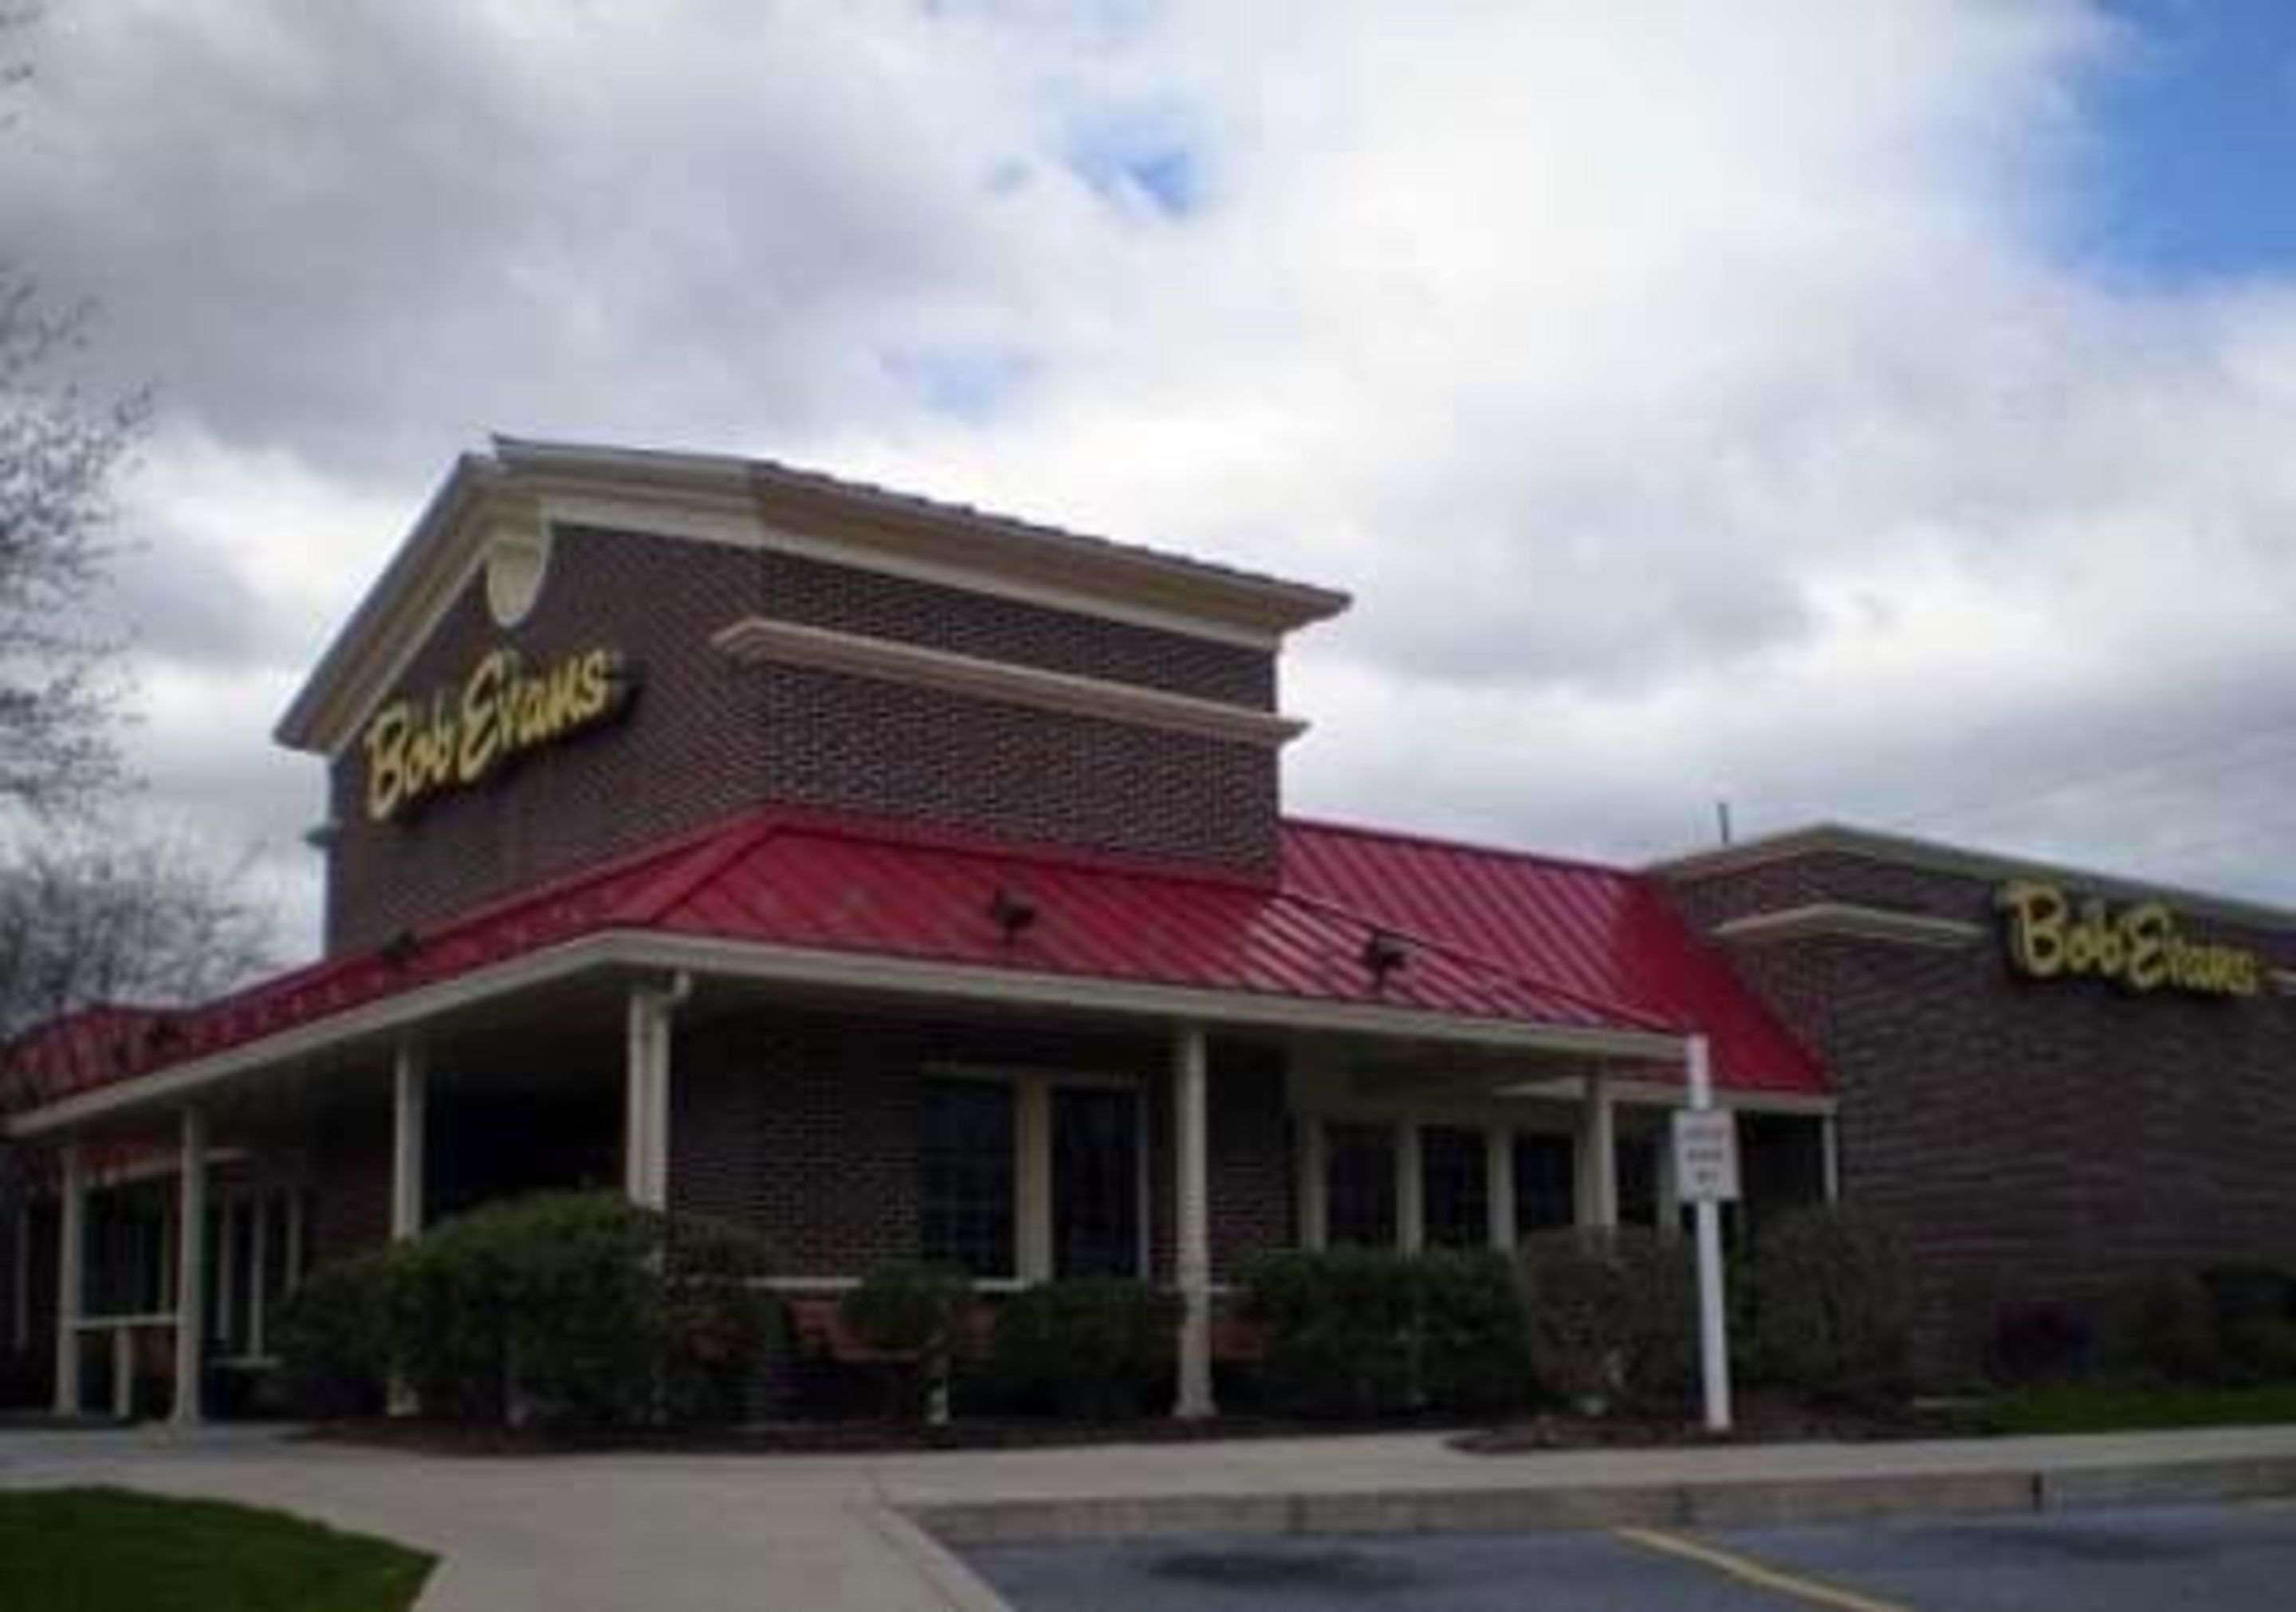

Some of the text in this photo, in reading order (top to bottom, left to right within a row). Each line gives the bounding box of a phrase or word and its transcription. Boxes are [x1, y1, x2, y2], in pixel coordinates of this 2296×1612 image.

[364, 649, 610, 820] Bob Evans
[2002, 881, 2256, 994] Bob Evans
